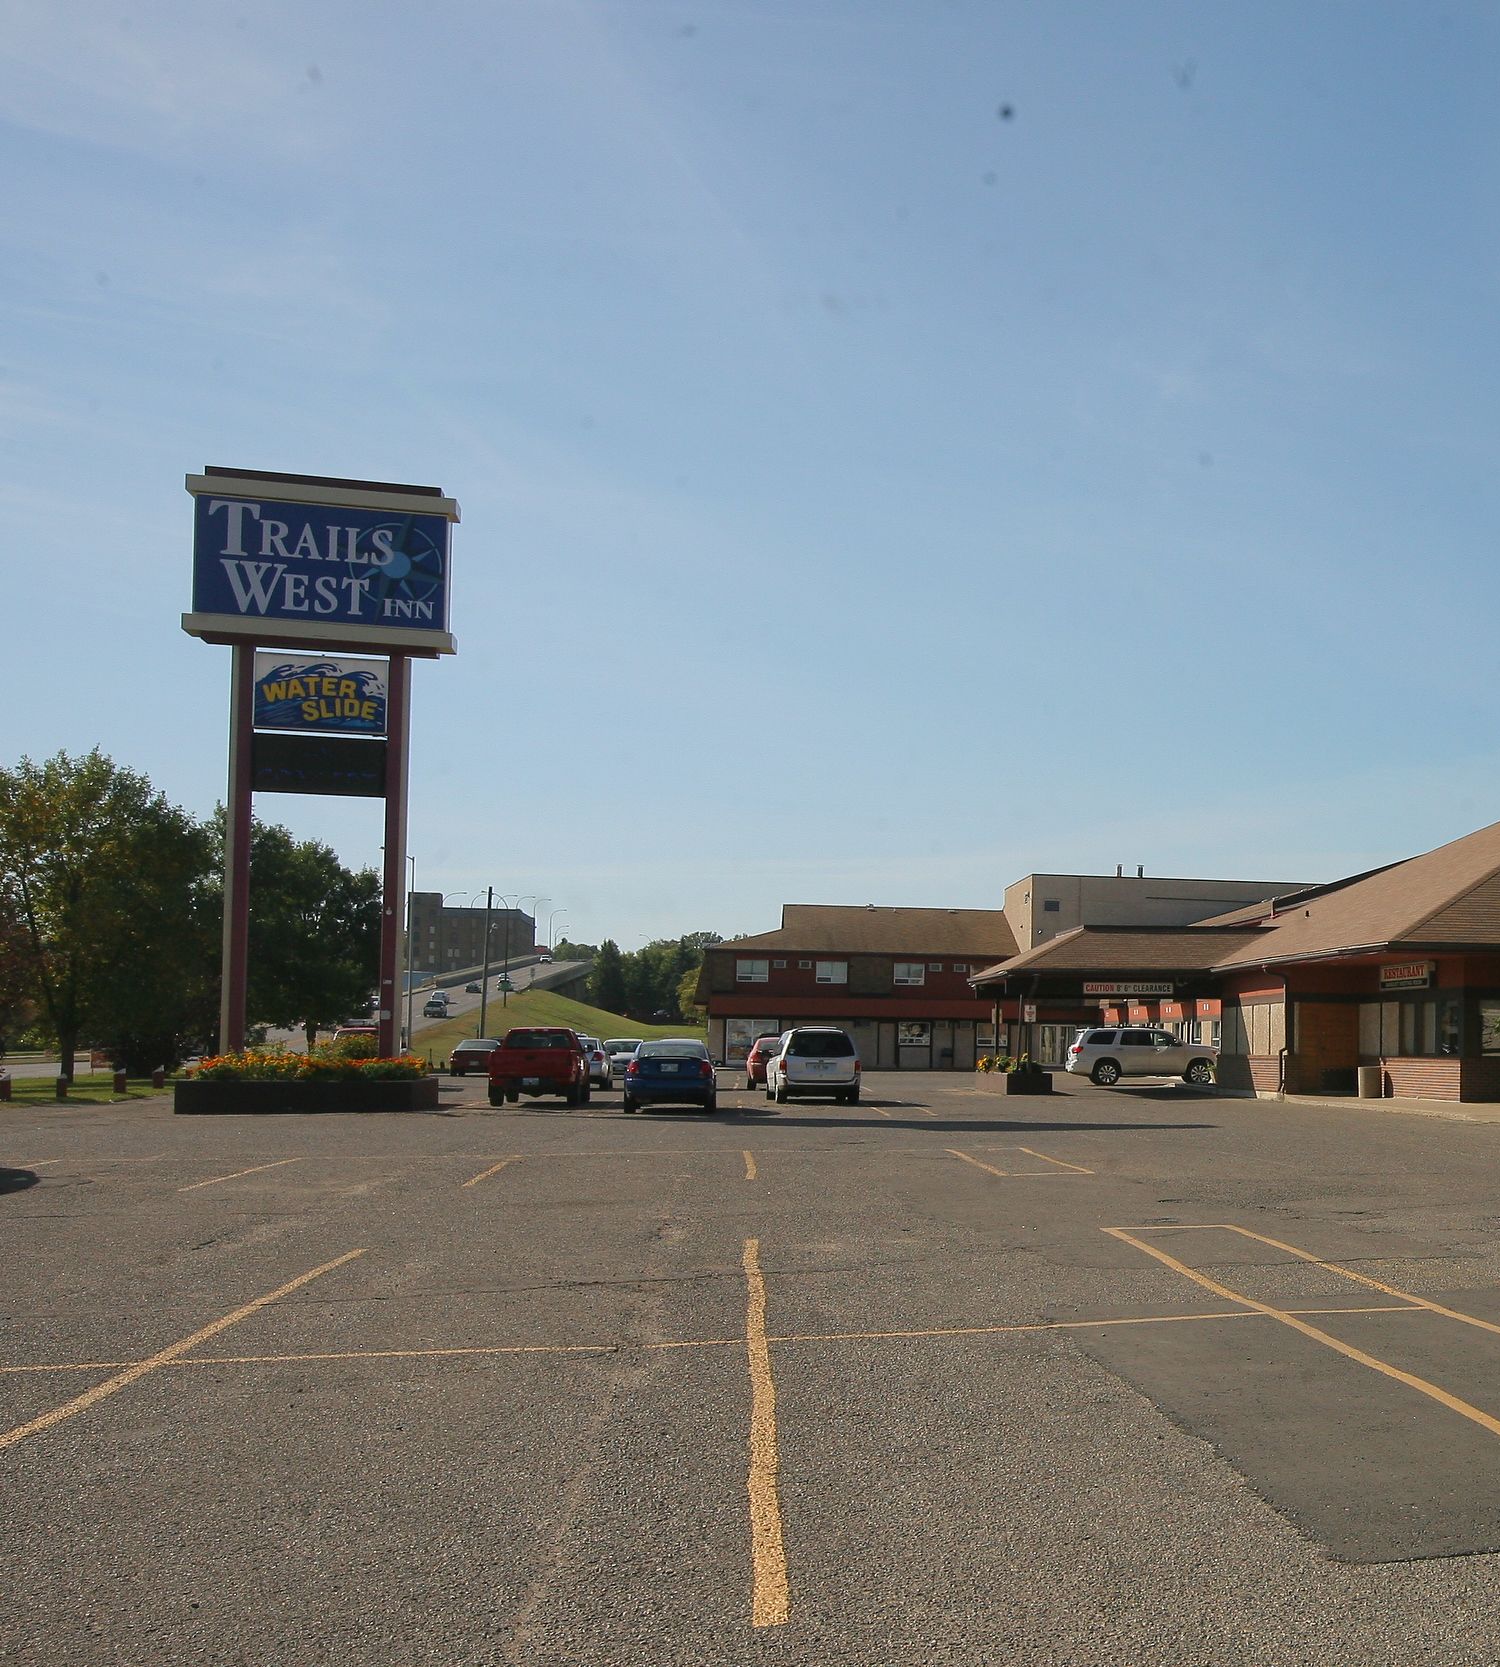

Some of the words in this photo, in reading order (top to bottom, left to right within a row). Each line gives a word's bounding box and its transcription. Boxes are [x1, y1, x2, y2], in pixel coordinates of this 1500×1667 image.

[208, 500, 394, 566] TRAILS
[219, 558, 370, 615] WEST
[383, 598, 435, 620] INN
[262, 675, 358, 703] WATER
[301, 699, 379, 721] SLIDE
[1383, 964, 1425, 979] RESTAURANT
[1085, 984, 1115, 992] CAUTION
[1132, 984, 1172, 993] CLEARANCE
